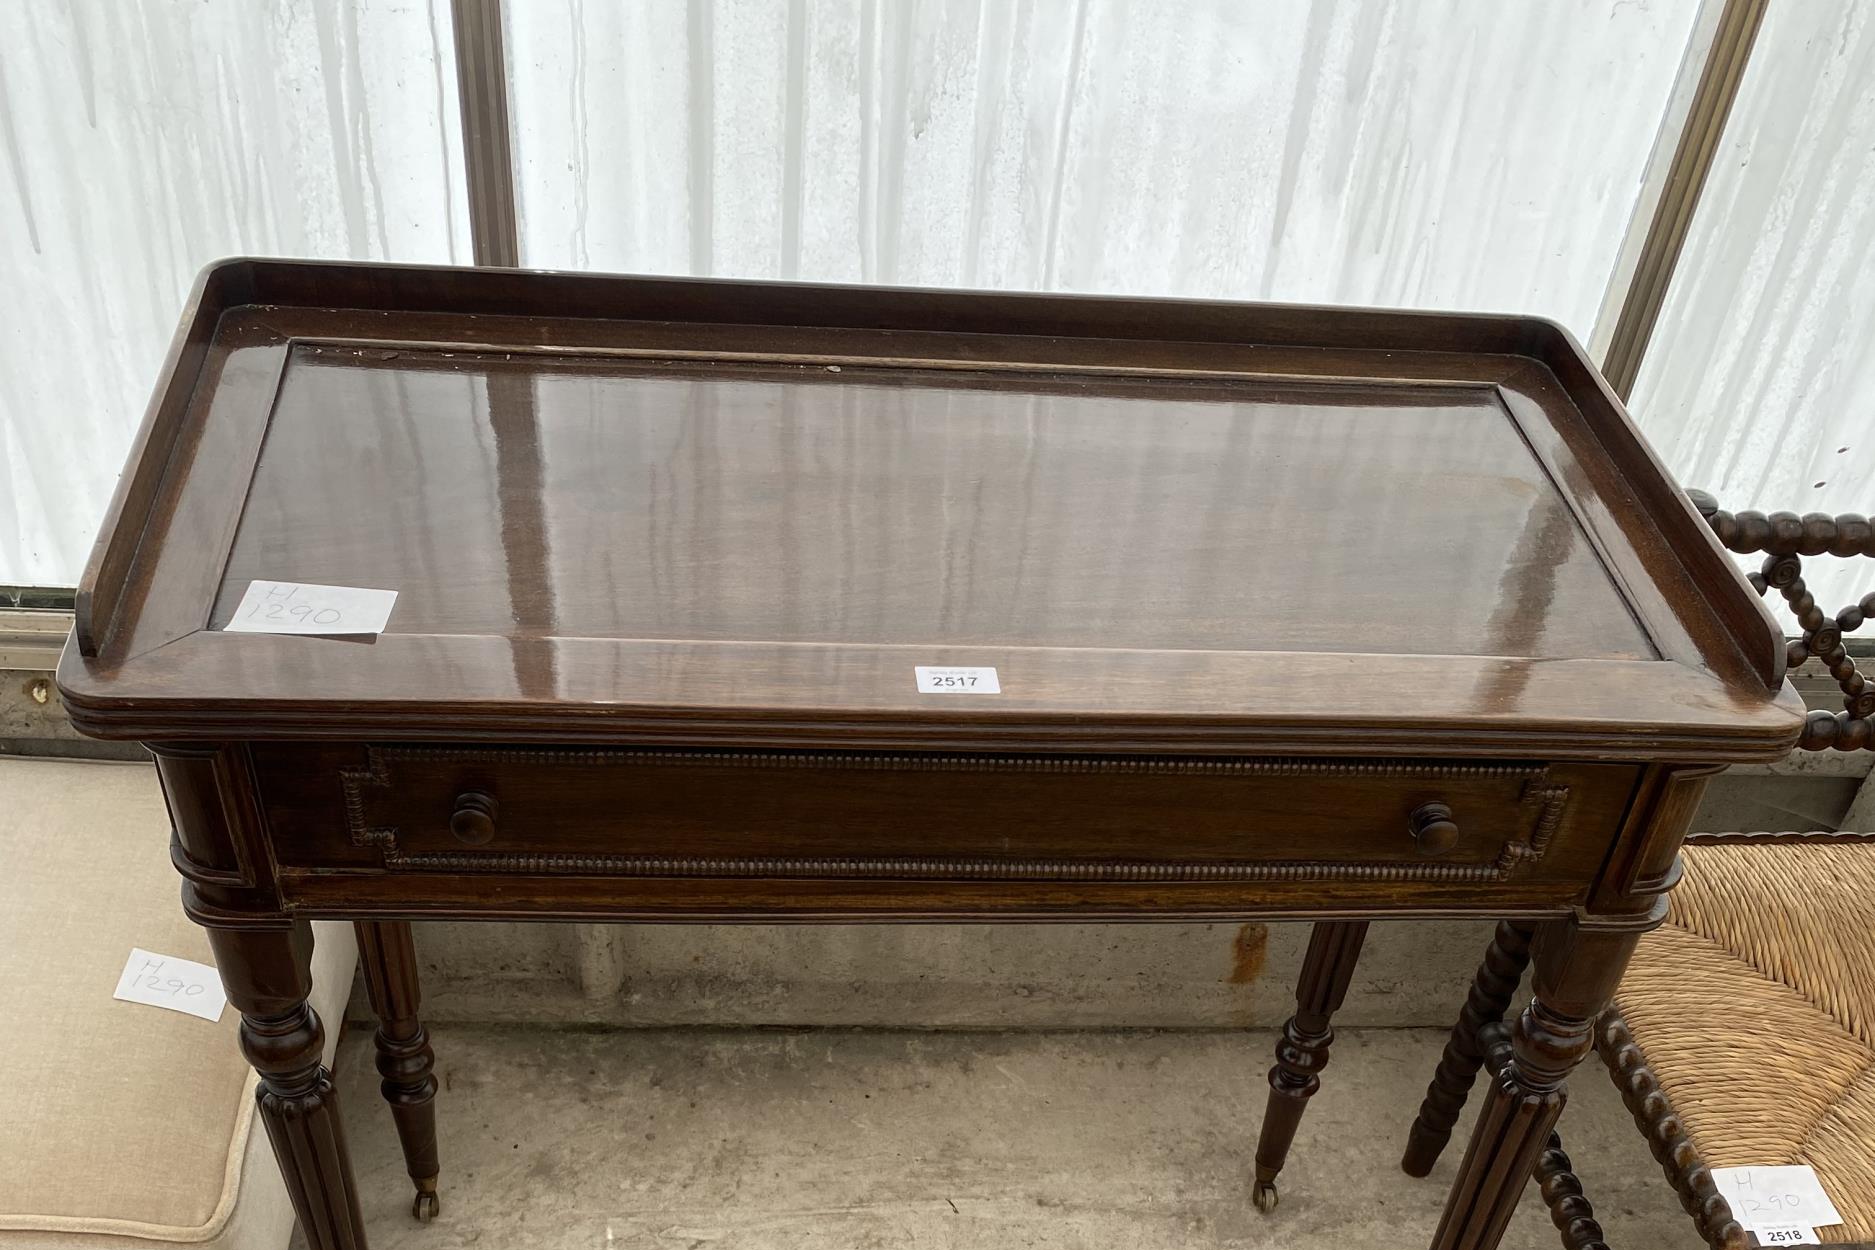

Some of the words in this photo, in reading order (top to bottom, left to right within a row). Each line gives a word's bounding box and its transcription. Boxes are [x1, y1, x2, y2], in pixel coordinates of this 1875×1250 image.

[265, 585, 298, 600] H
[248, 603, 342, 625] 1290
[932, 676, 978, 687] 2517
[140, 959, 166, 975] H
[132, 974, 205, 996] 1290
[1734, 1169, 1753, 1191] H
[1738, 1193, 1801, 1217] 1290
[1767, 1230, 1803, 1242] 2518
